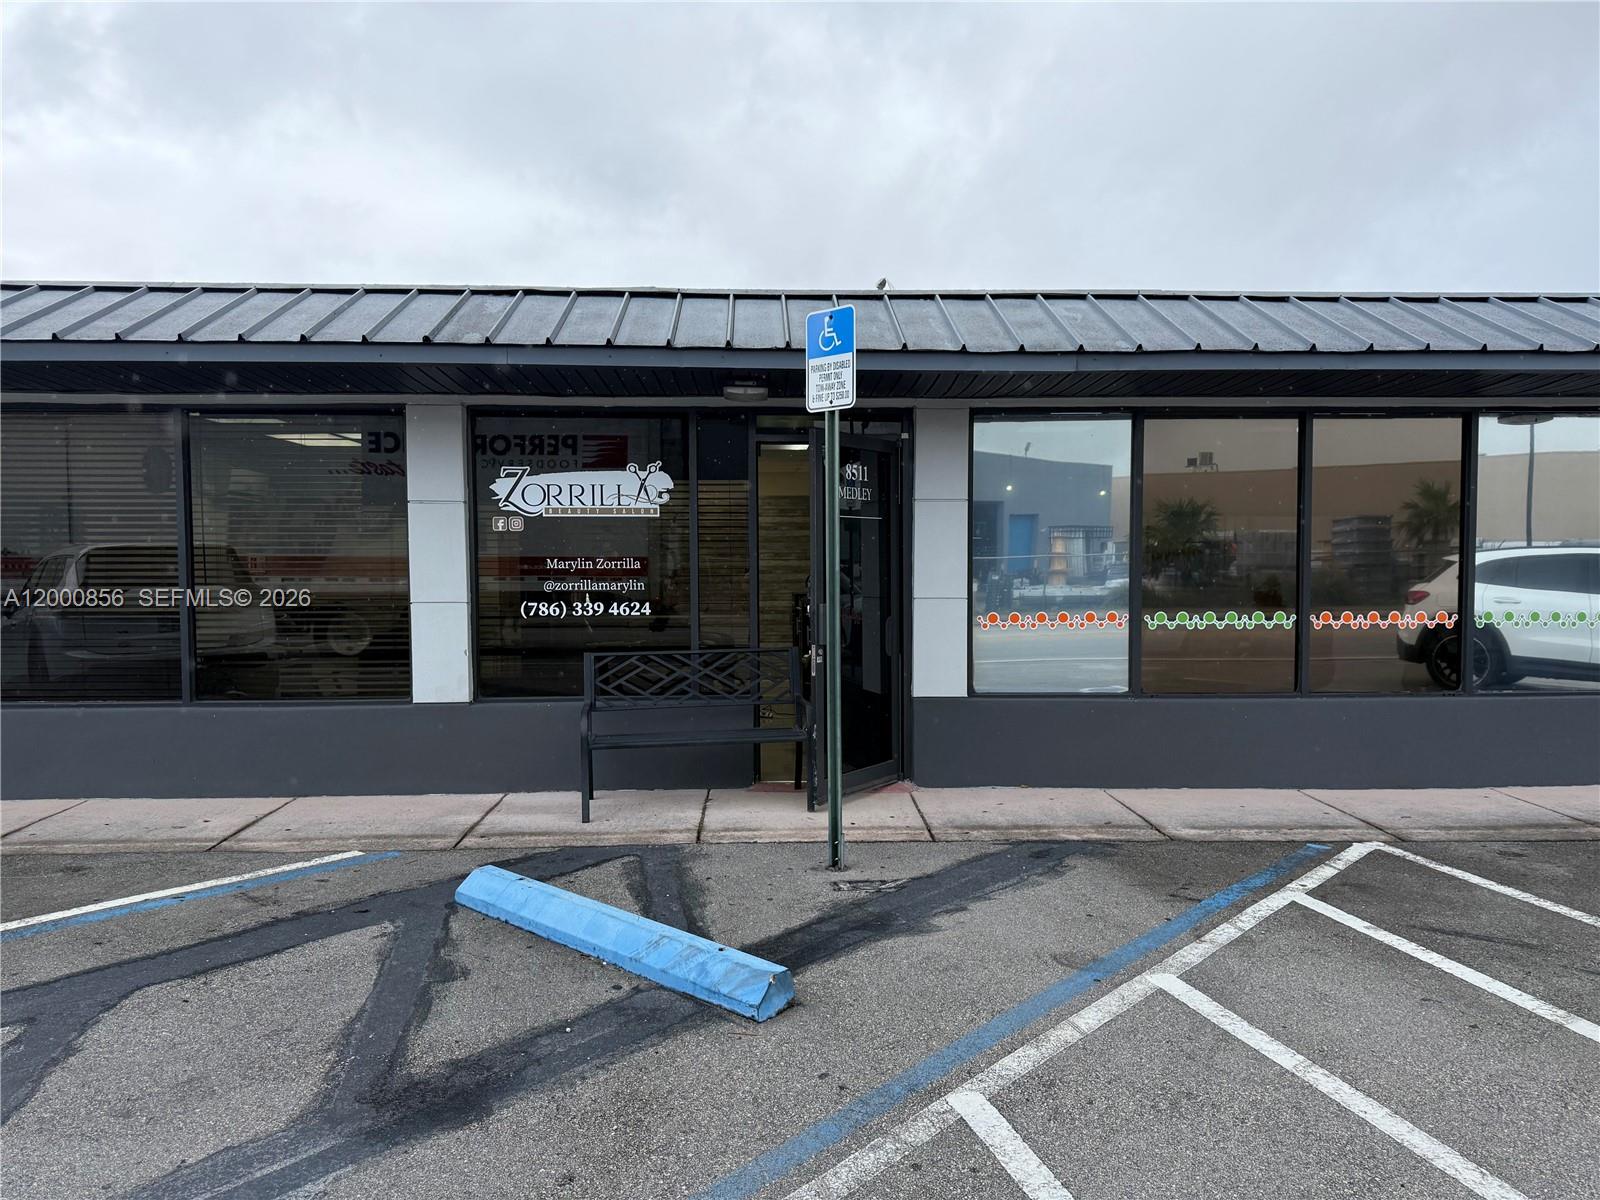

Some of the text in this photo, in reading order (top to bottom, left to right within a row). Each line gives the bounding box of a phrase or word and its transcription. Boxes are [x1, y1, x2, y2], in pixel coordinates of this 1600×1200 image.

[833, 359, 850, 370] DISABLED
[818, 370, 843, 383] PERMIT ONLY
[836, 380, 846, 390] ZONE
[845, 463, 869, 481] 8511
[498, 466, 658, 517] ZORRILLA
[838, 486, 873, 501] MEDLEY
[546, 558, 641, 572] Marylin Zorrilla
[543, 580, 645, 593] @zorrillamarylin
[520, 601, 652, 619] (786) 339 4624
